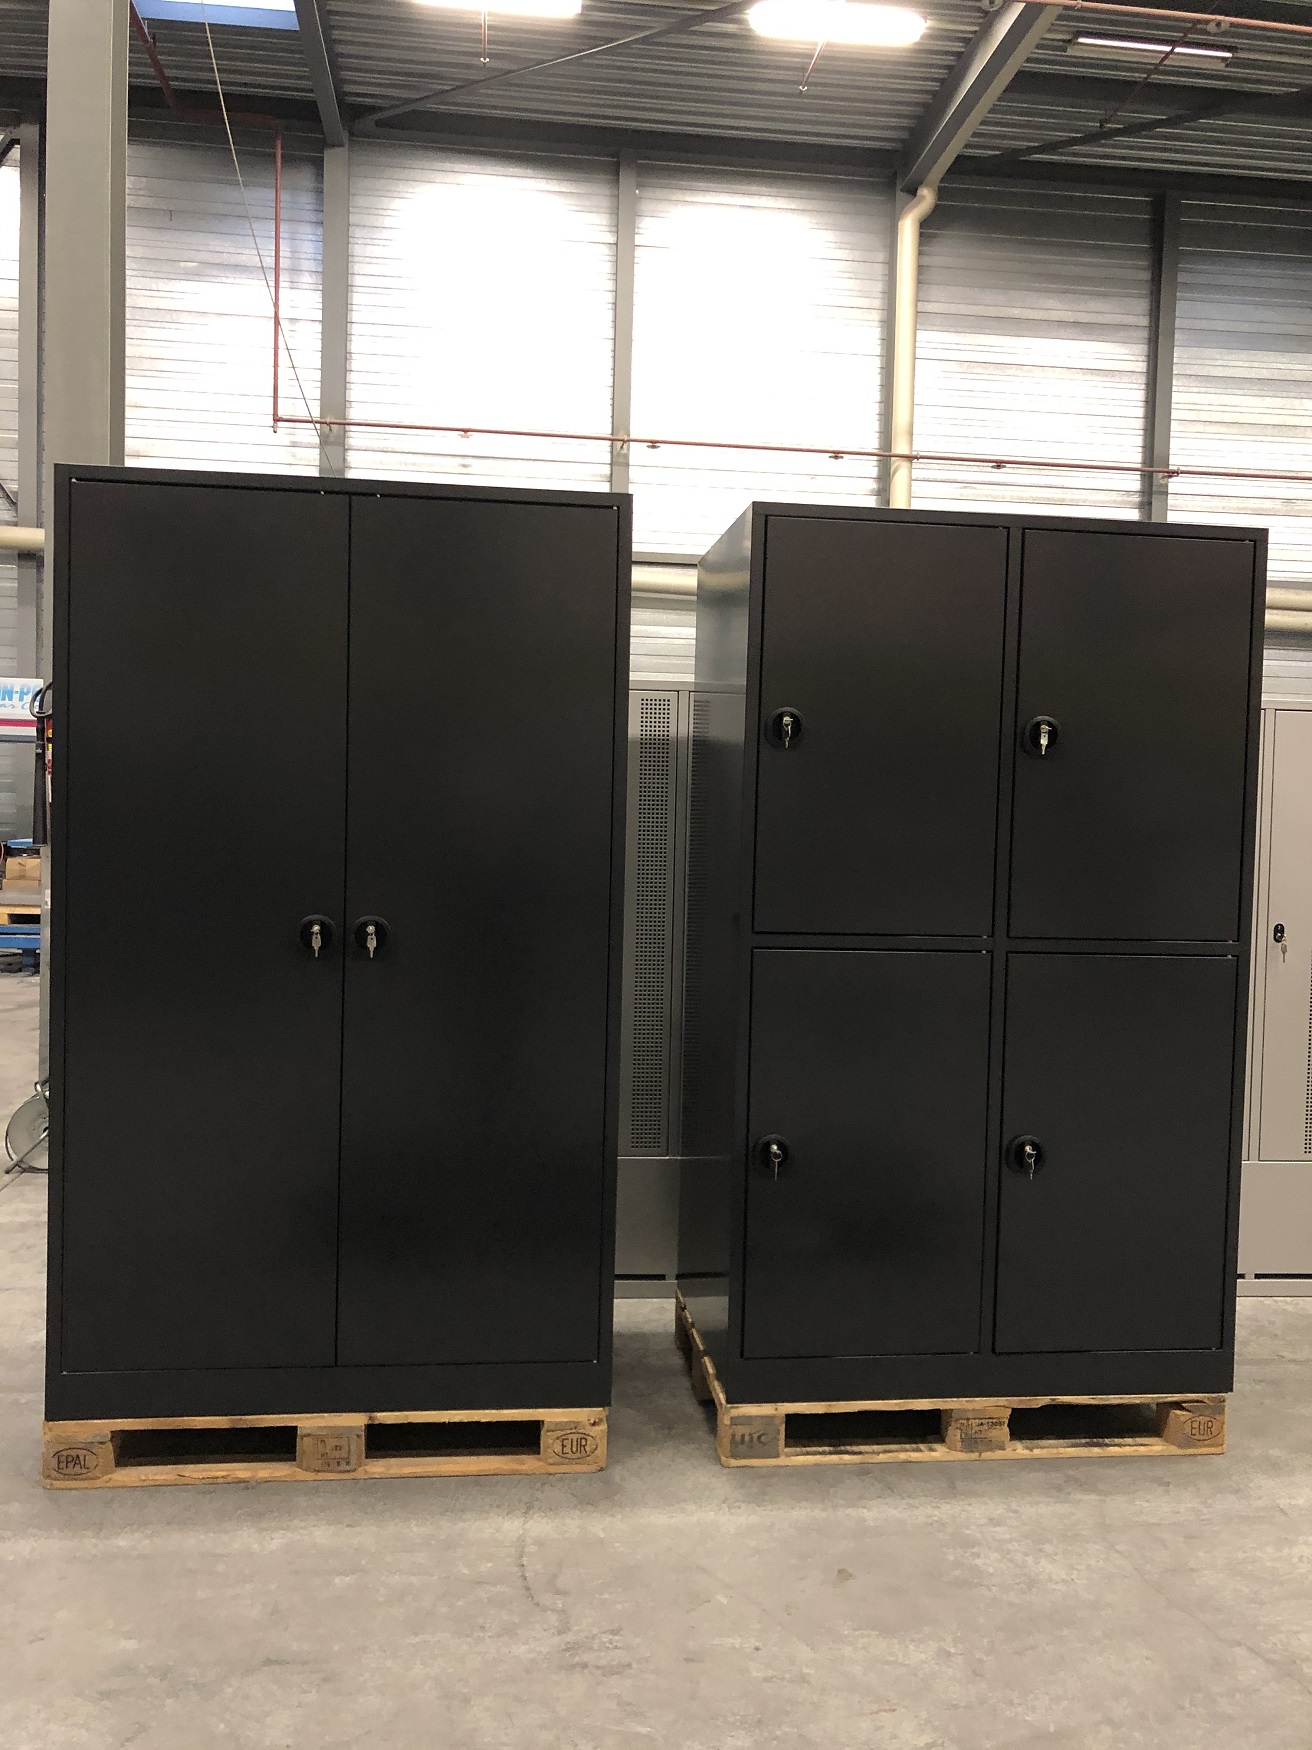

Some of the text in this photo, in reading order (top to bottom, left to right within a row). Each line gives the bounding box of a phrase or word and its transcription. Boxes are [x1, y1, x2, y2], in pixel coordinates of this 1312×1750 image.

[1190, 1420, 1213, 1436] EUR
[561, 1437, 588, 1455] EUR
[57, 1454, 90, 1470] EPAL
